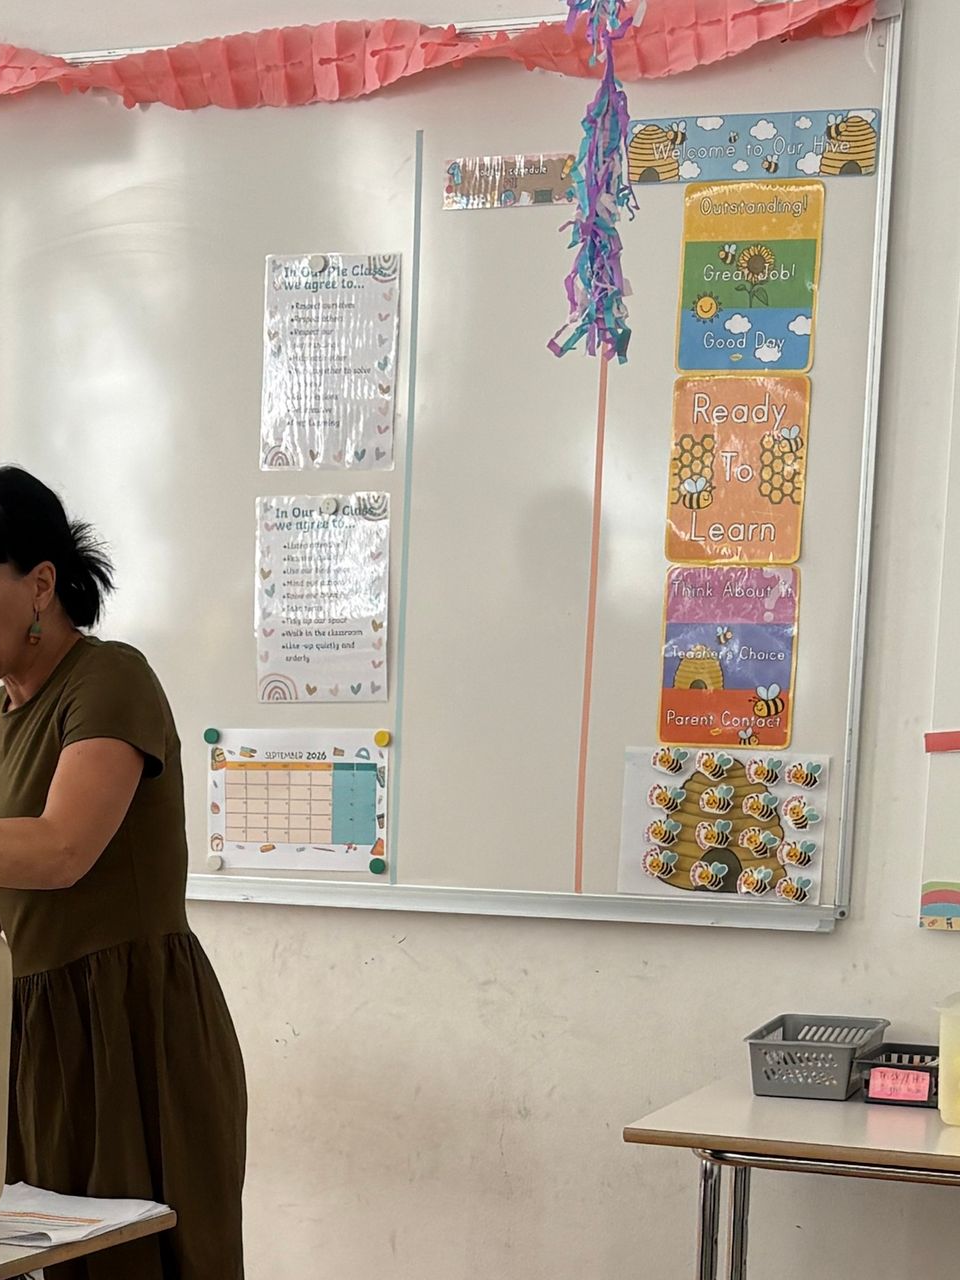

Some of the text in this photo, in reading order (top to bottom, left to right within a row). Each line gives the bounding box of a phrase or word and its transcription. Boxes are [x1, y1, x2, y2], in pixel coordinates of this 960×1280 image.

[652, 134, 851, 160] Welcome to Our Hive
[700, 195, 808, 217] Outstanding!
[284, 267, 296, 278] In
[703, 263, 796, 281] Great Job!
[283, 279, 365, 293] we agree to...
[703, 331, 786, 350] Good Day
[692, 392, 787, 430] Ready
[721, 451, 753, 482] To
[275, 508, 288, 518] In
[292, 507, 315, 519] Our
[274, 522, 294, 531] we
[296, 521, 329, 533] agree
[690, 511, 777, 542] Learn
[672, 580, 713, 598] Think
[722, 582, 772, 598] About
[672, 645, 786, 662] Teacher's Choice
[666, 710, 782, 728] Parent Contact
[264, 751, 327, 760] SEPTEMBER 2026
